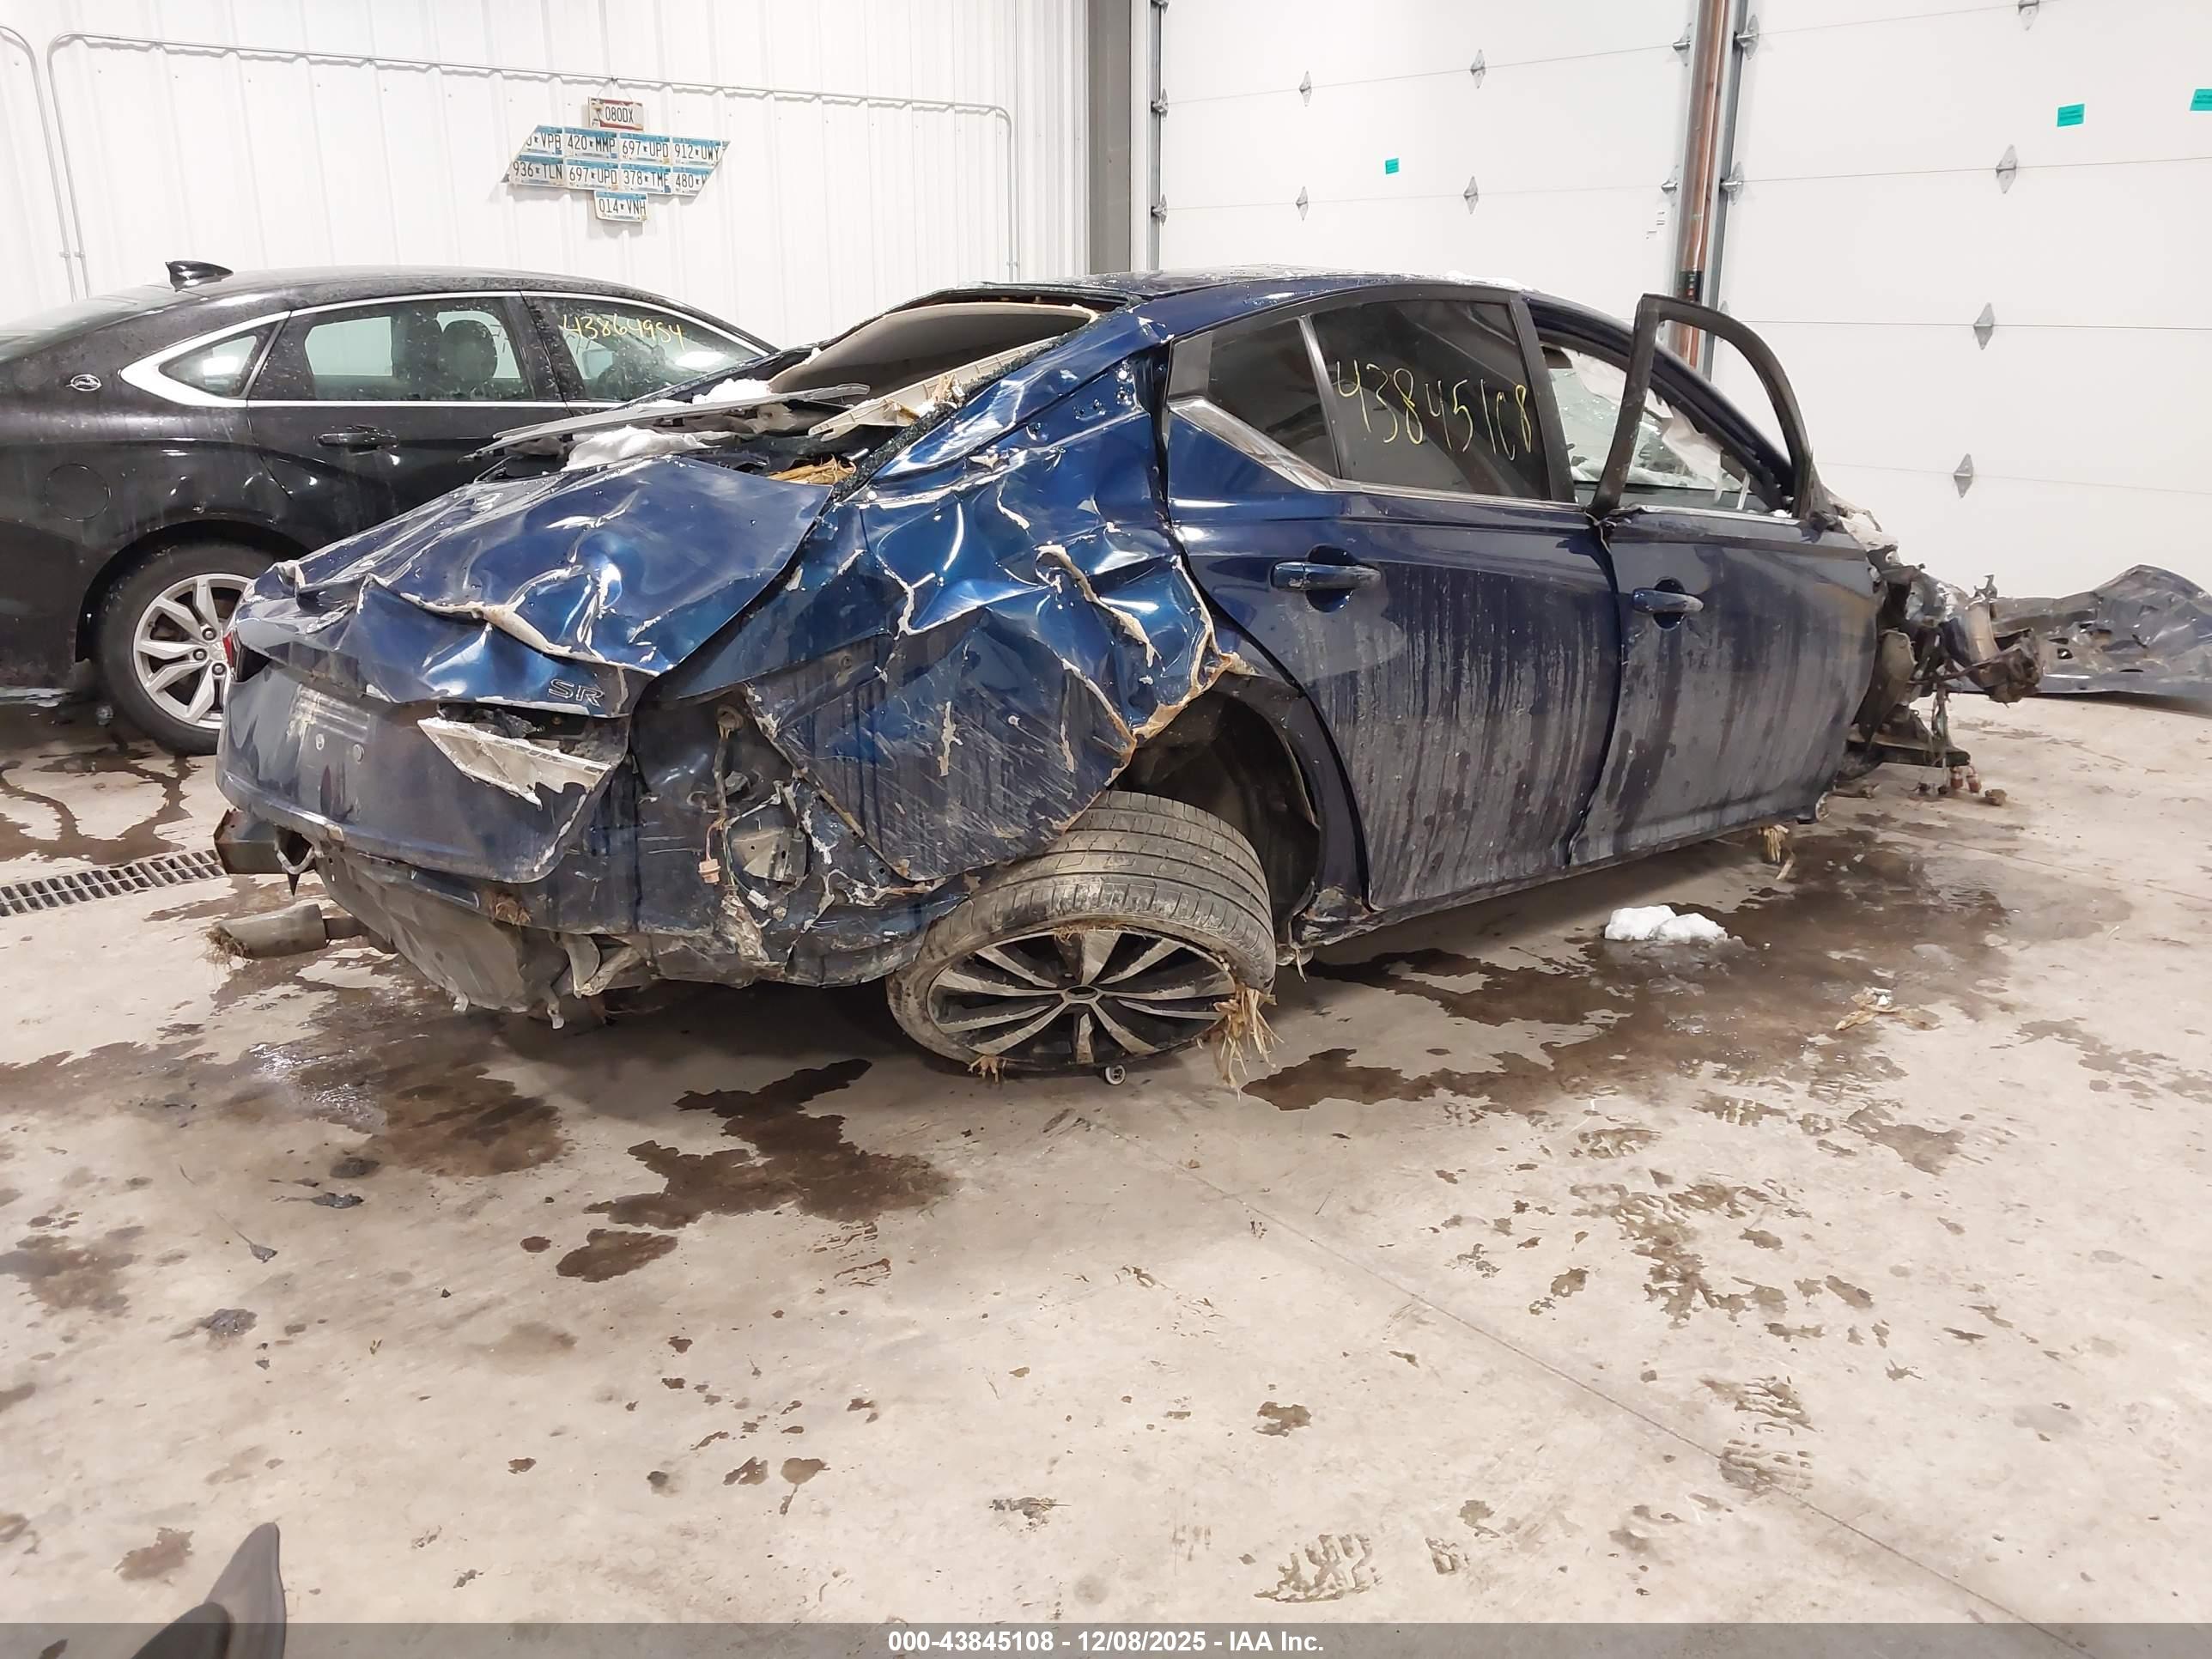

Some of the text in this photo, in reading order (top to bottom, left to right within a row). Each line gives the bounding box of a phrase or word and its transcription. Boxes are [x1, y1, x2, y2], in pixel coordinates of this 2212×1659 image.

[568, 134, 587, 150] 420
[622, 140, 641, 155] 697
[674, 143, 694, 159] 912
[513, 161, 533, 177] 936
[569, 167, 588, 182] 697
[623, 170, 642, 185] 378
[675, 173, 694, 188] 480
[562, 313, 685, 350] 43864954
[549, 678, 605, 708] SR
